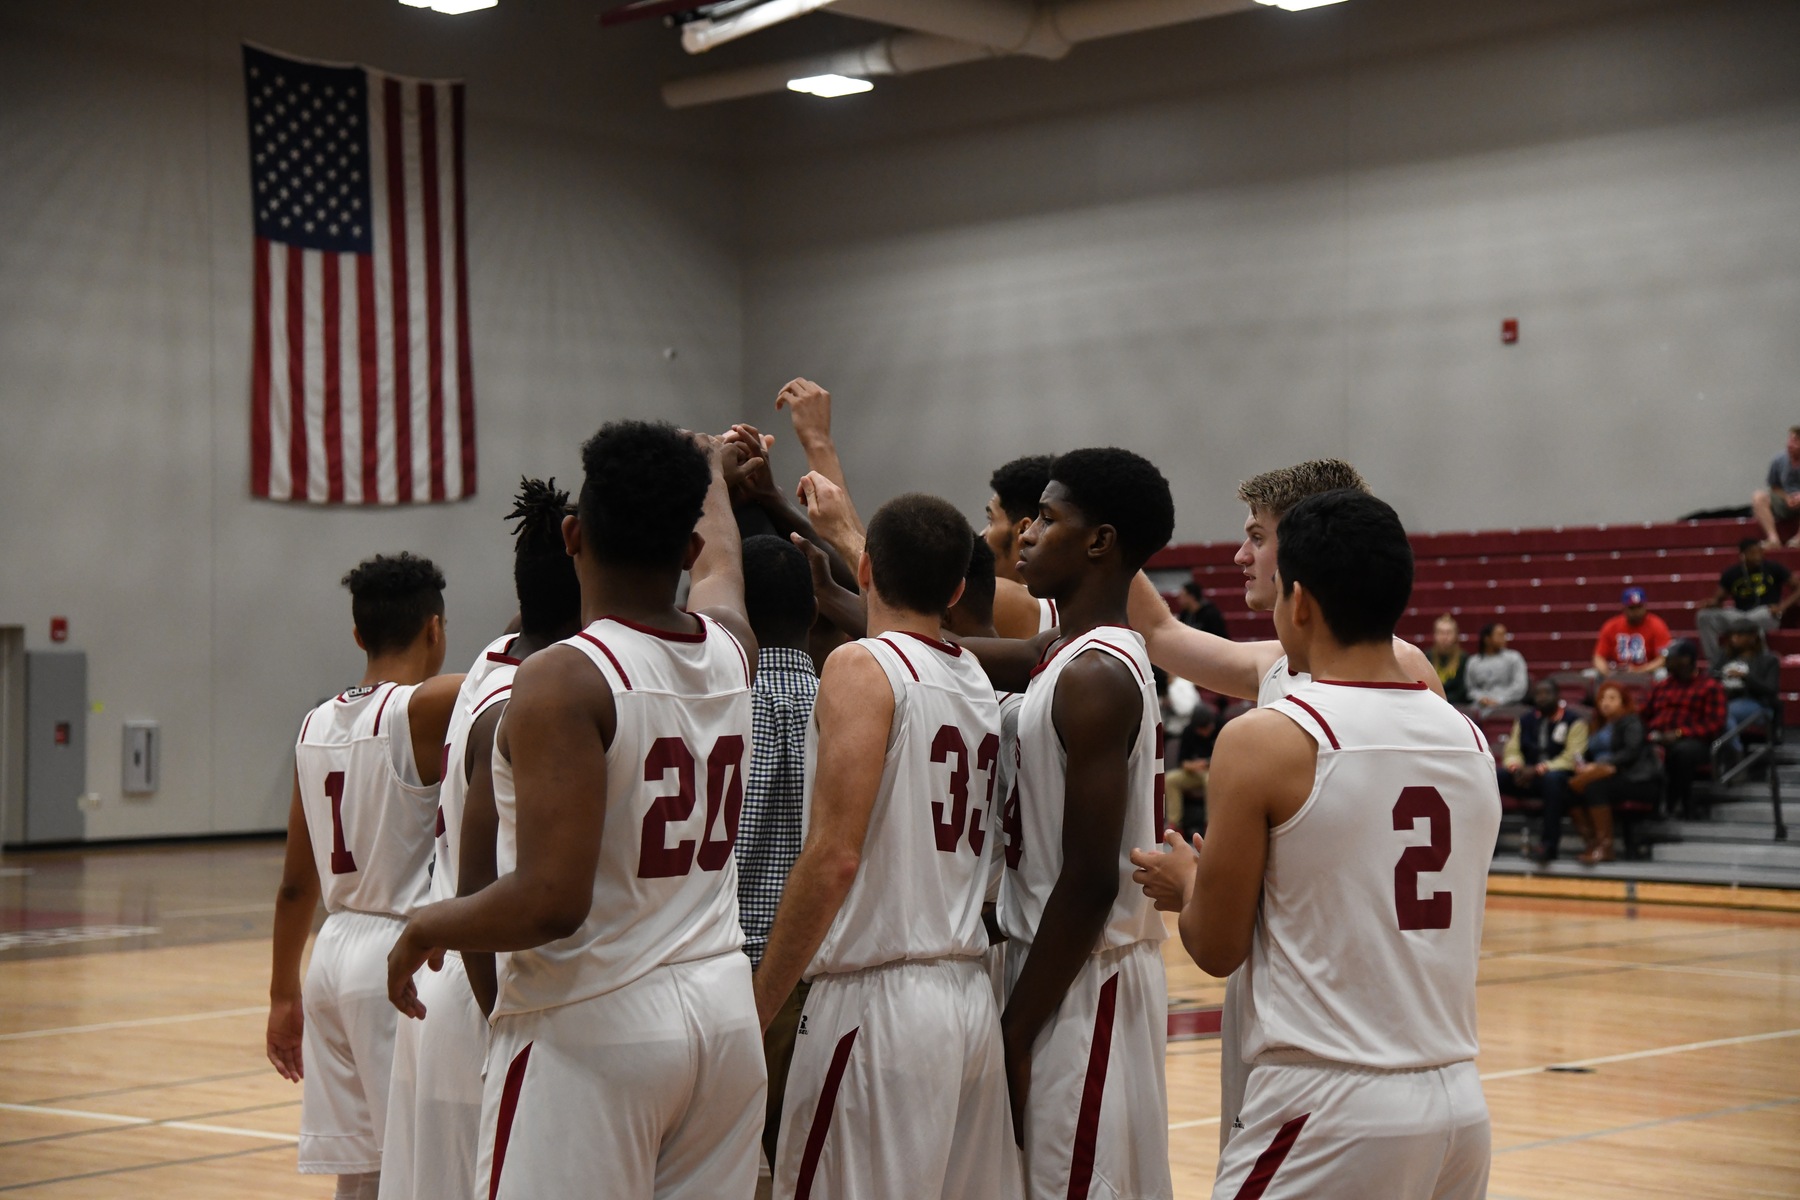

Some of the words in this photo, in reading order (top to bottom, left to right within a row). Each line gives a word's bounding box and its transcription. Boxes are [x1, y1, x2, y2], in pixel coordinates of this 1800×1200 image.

[325, 770, 358, 875] 1
[637, 734, 744, 878] 20
[929, 724, 999, 857] 33
[1392, 786, 1452, 930] 2
